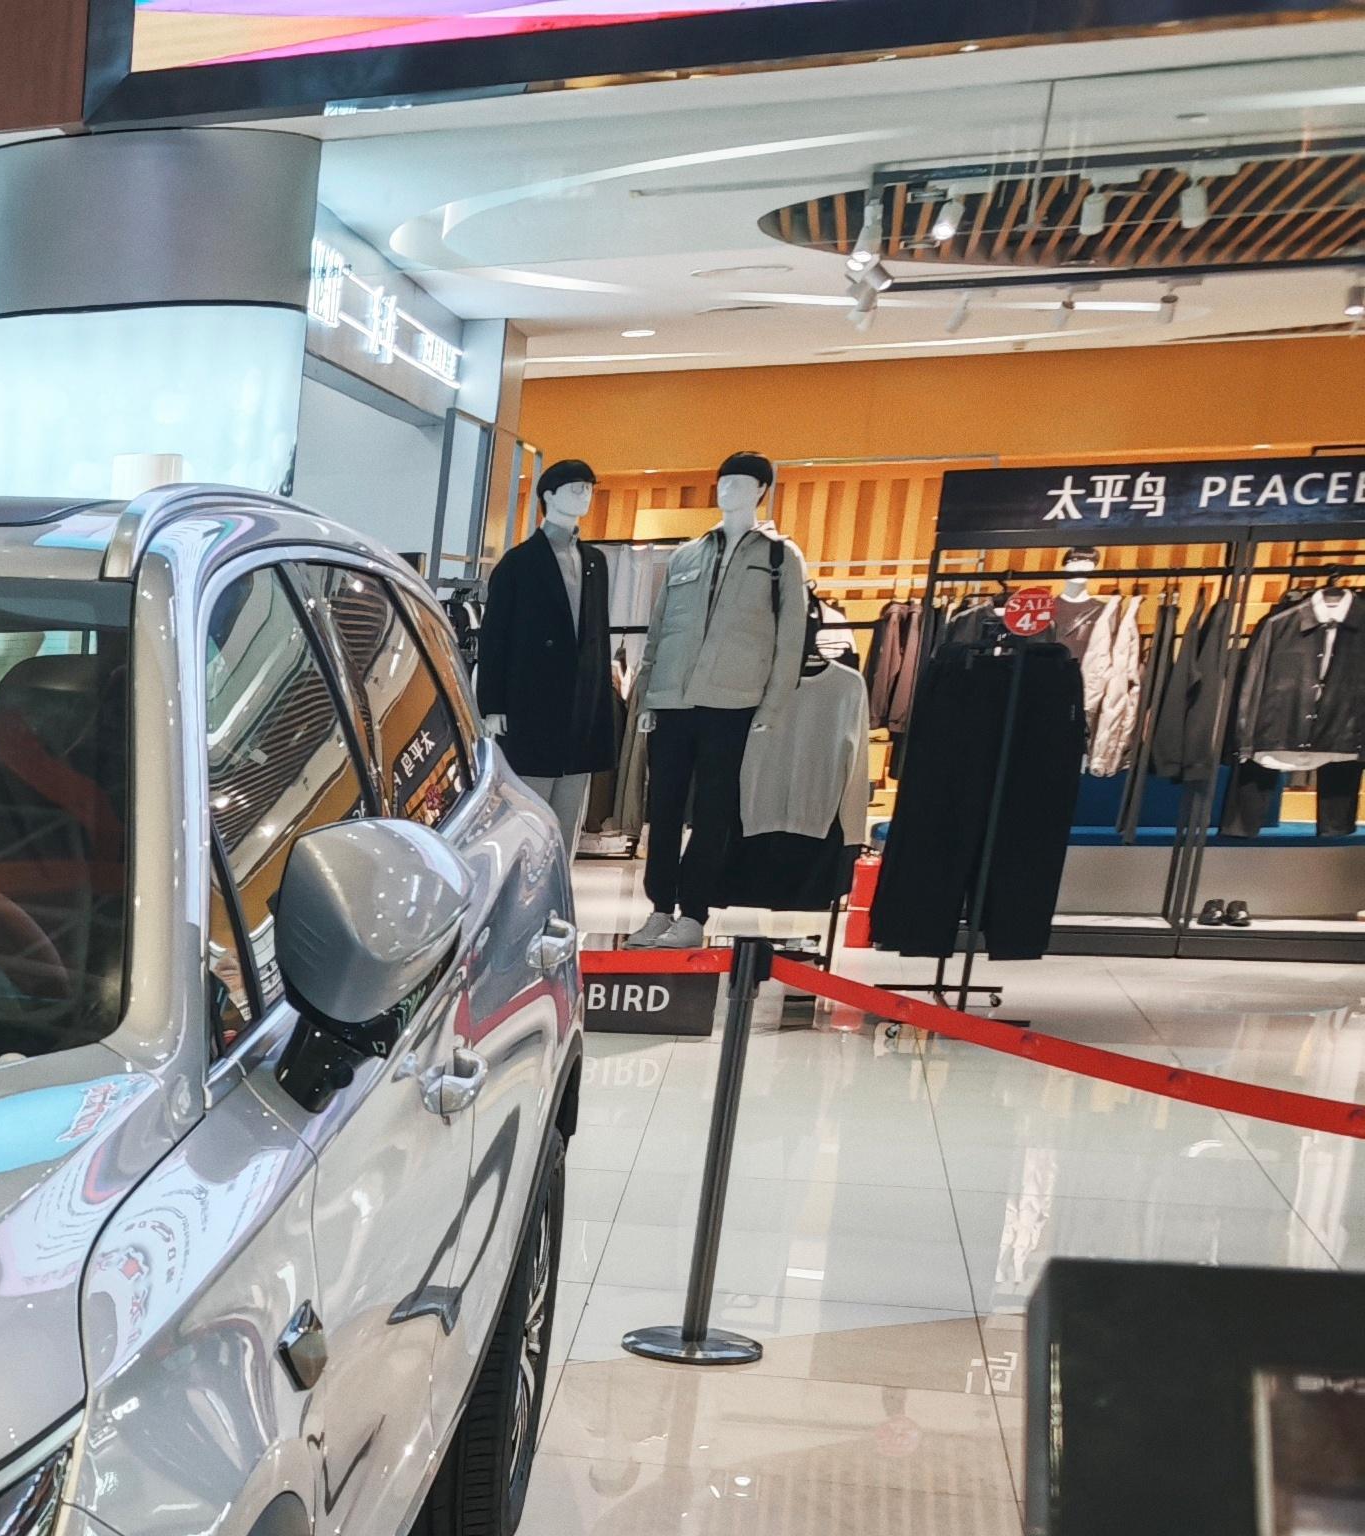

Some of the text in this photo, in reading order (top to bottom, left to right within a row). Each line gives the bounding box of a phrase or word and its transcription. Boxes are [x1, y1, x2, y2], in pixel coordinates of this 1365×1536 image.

[1043, 470, 1167, 521] 太平鸟
[1006, 598, 1056, 613] SALE
[587, 984, 671, 1014] BIRD
